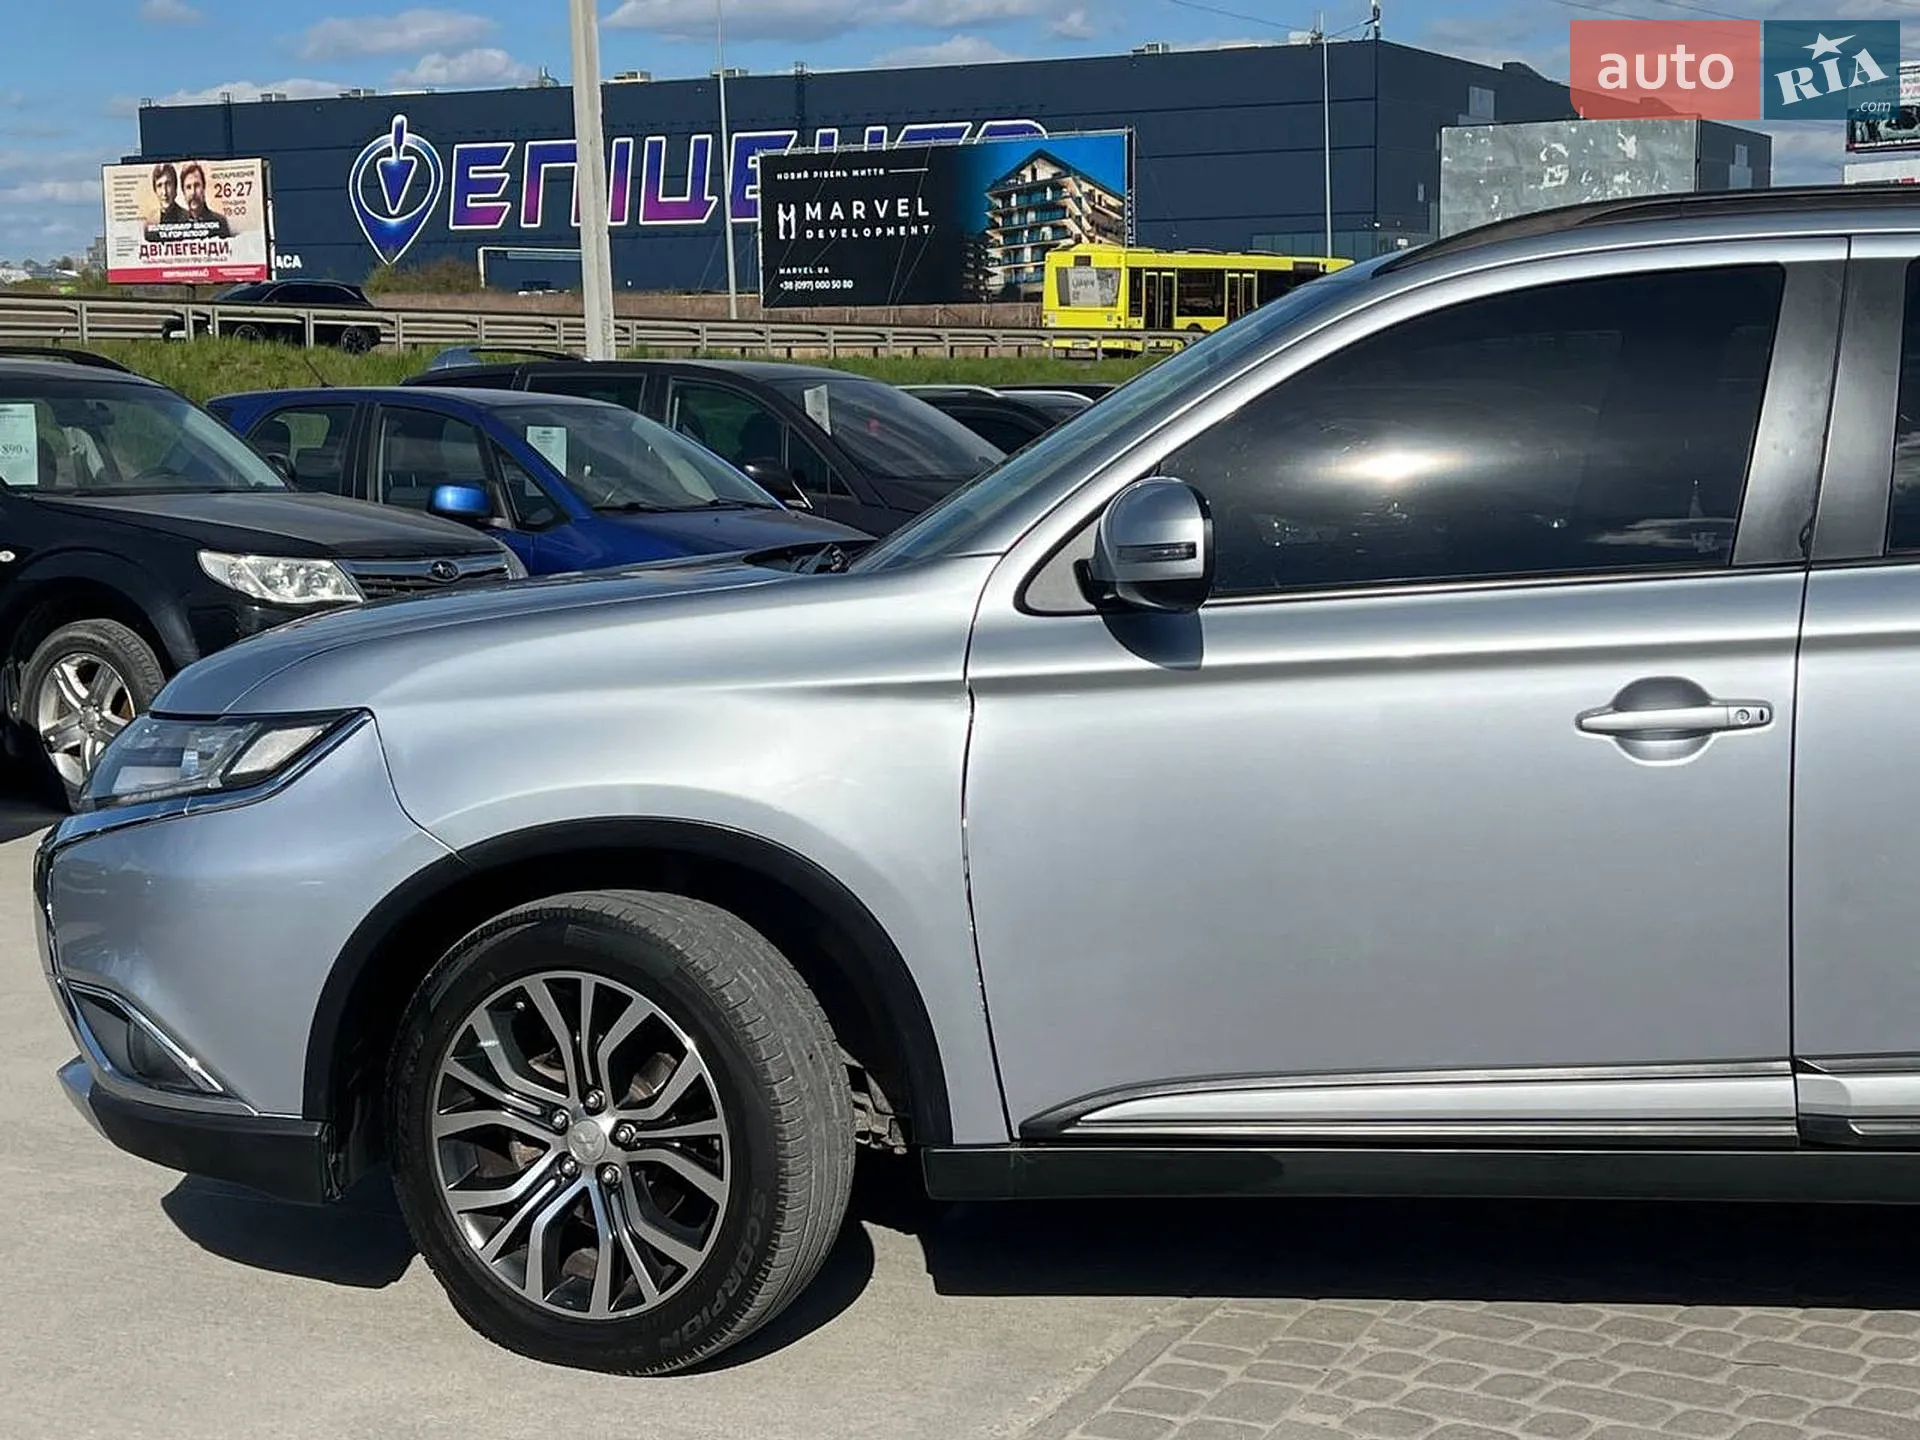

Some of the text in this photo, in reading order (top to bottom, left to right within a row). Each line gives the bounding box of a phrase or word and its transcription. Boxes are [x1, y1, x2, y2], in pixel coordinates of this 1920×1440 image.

[449, 119, 1048, 230] ЕПІЦЕ
[805, 197, 930, 221] MARVEL
[806, 224, 930, 239] DEVELOPMENT
[139, 244, 163, 260] ДВІ
[814, 280, 831, 289] 000
